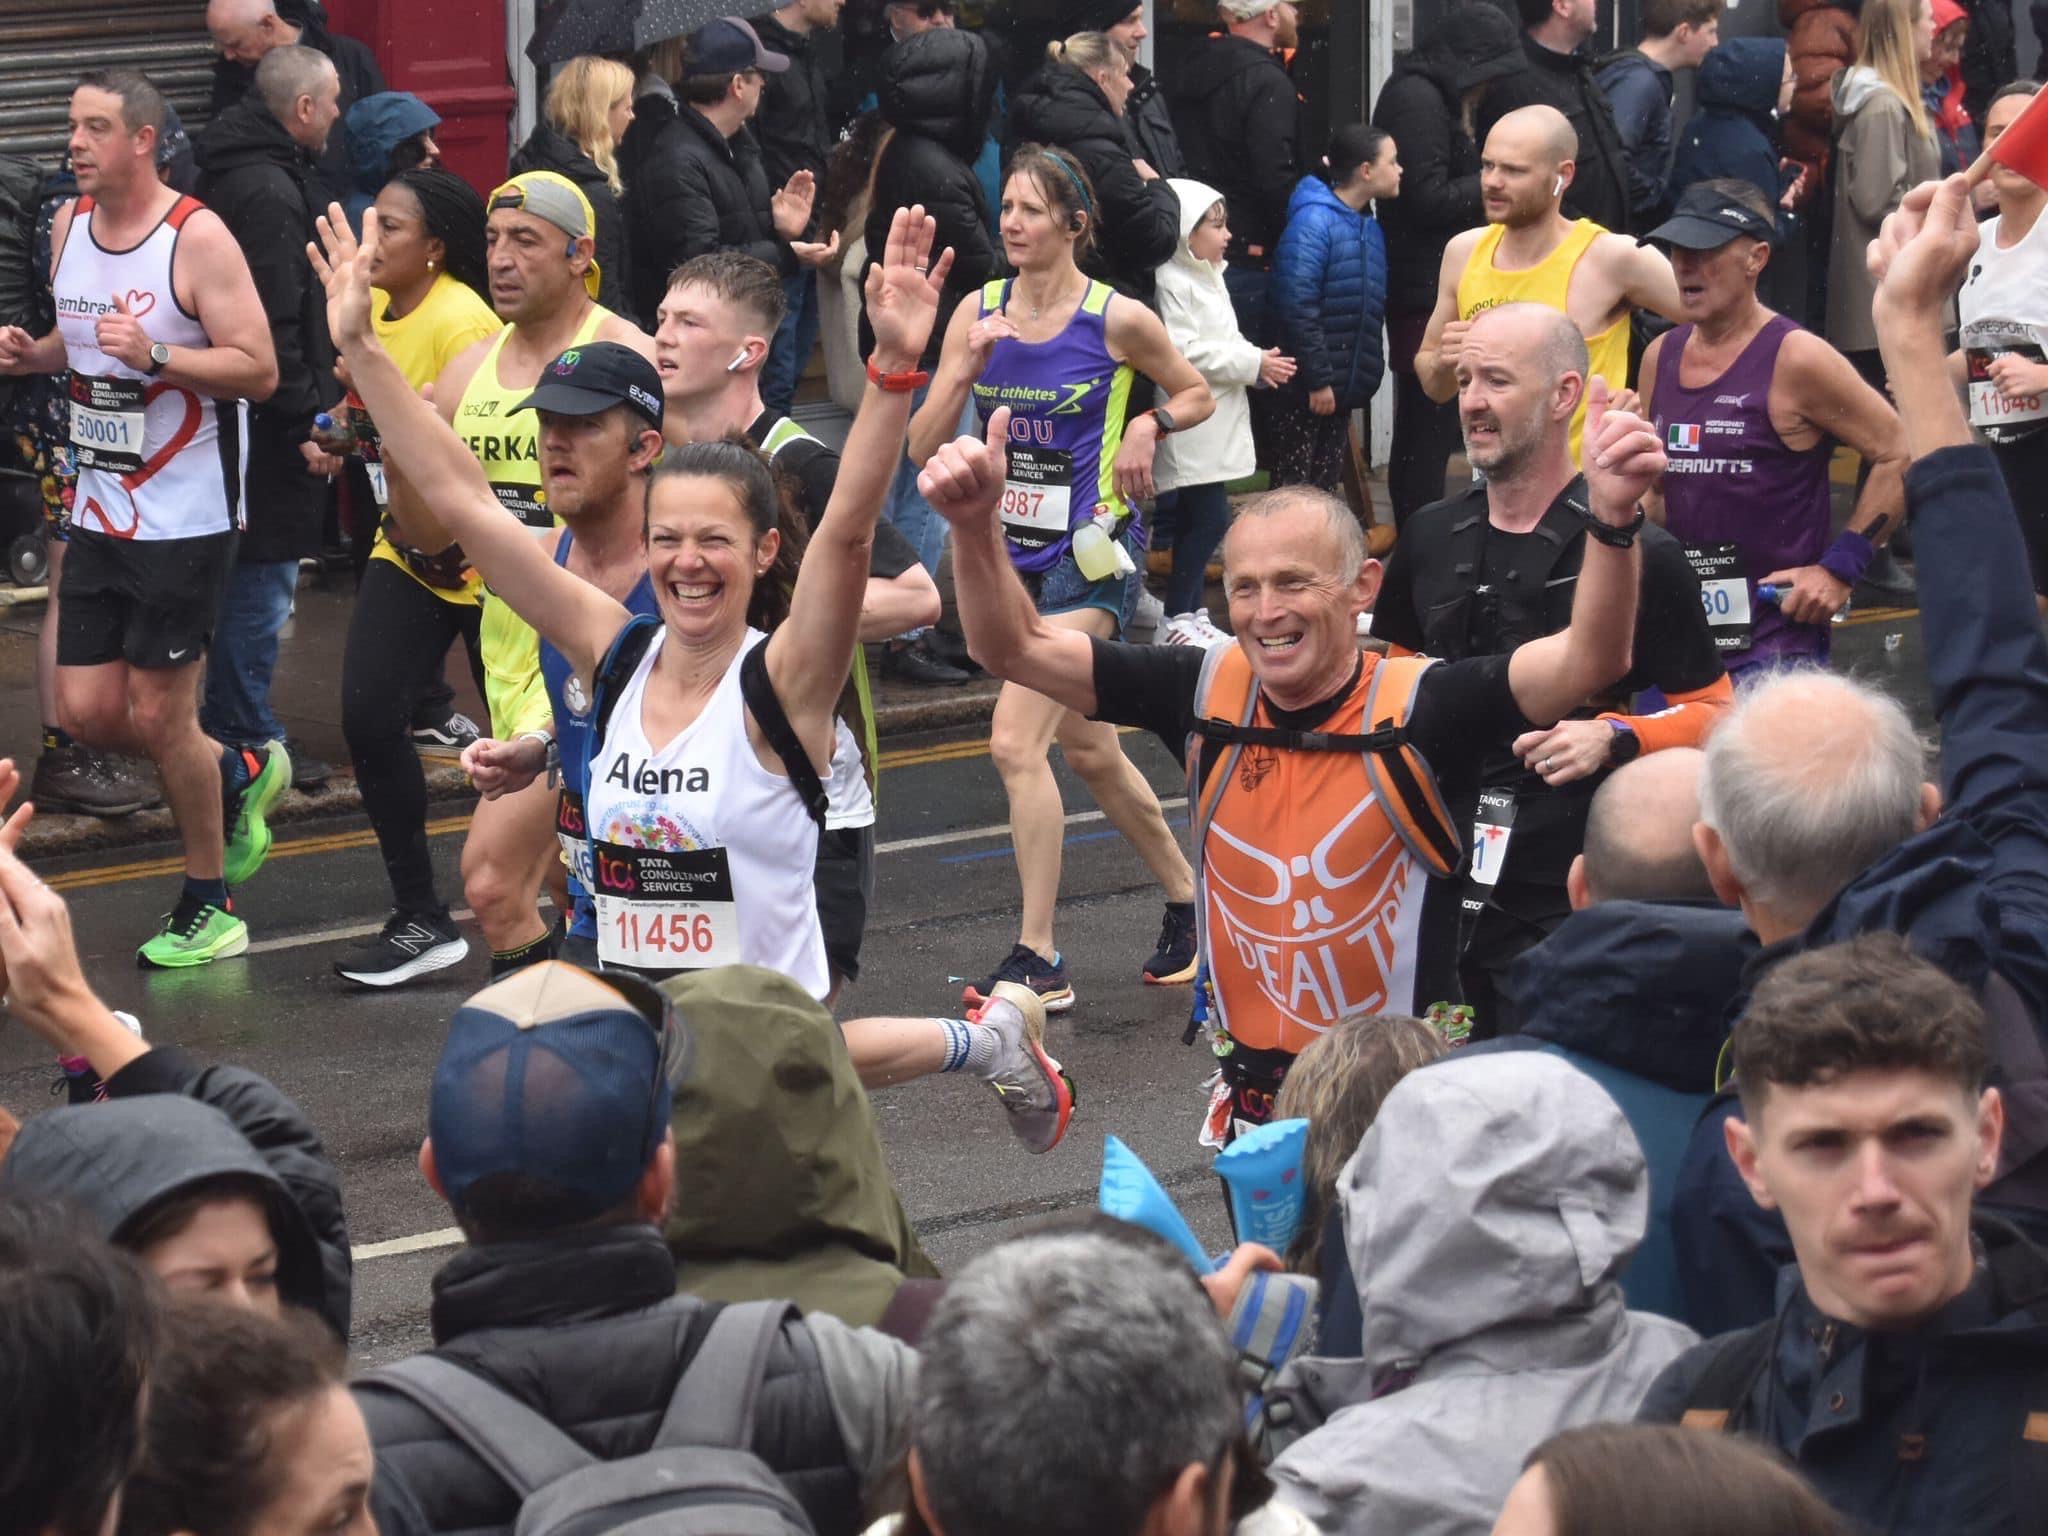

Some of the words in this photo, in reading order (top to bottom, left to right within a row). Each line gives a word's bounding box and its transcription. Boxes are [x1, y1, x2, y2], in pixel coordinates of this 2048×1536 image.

[58, 296, 119, 315] embrac
[92, 381, 111, 390] TATA
[91, 390, 138, 400] CONSULTANCY
[1000, 386, 1057, 400] athletes
[77, 414, 129, 445] 50001
[1008, 417, 1053, 444] OU
[462, 436, 538, 460] ERKA
[1012, 452, 1033, 461] TATA
[1012, 461, 1064, 472] CONSULTANCY
[1013, 469, 1044, 479] SERVICES
[496, 489, 519, 498] TATA
[997, 490, 1044, 518] 987
[605, 752, 709, 795] Alena
[638, 858, 671, 868] TATA
[640, 869, 717, 882] CONSULTANCY
[642, 881, 693, 892] SERVICES
[616, 911, 713, 953] 11456
